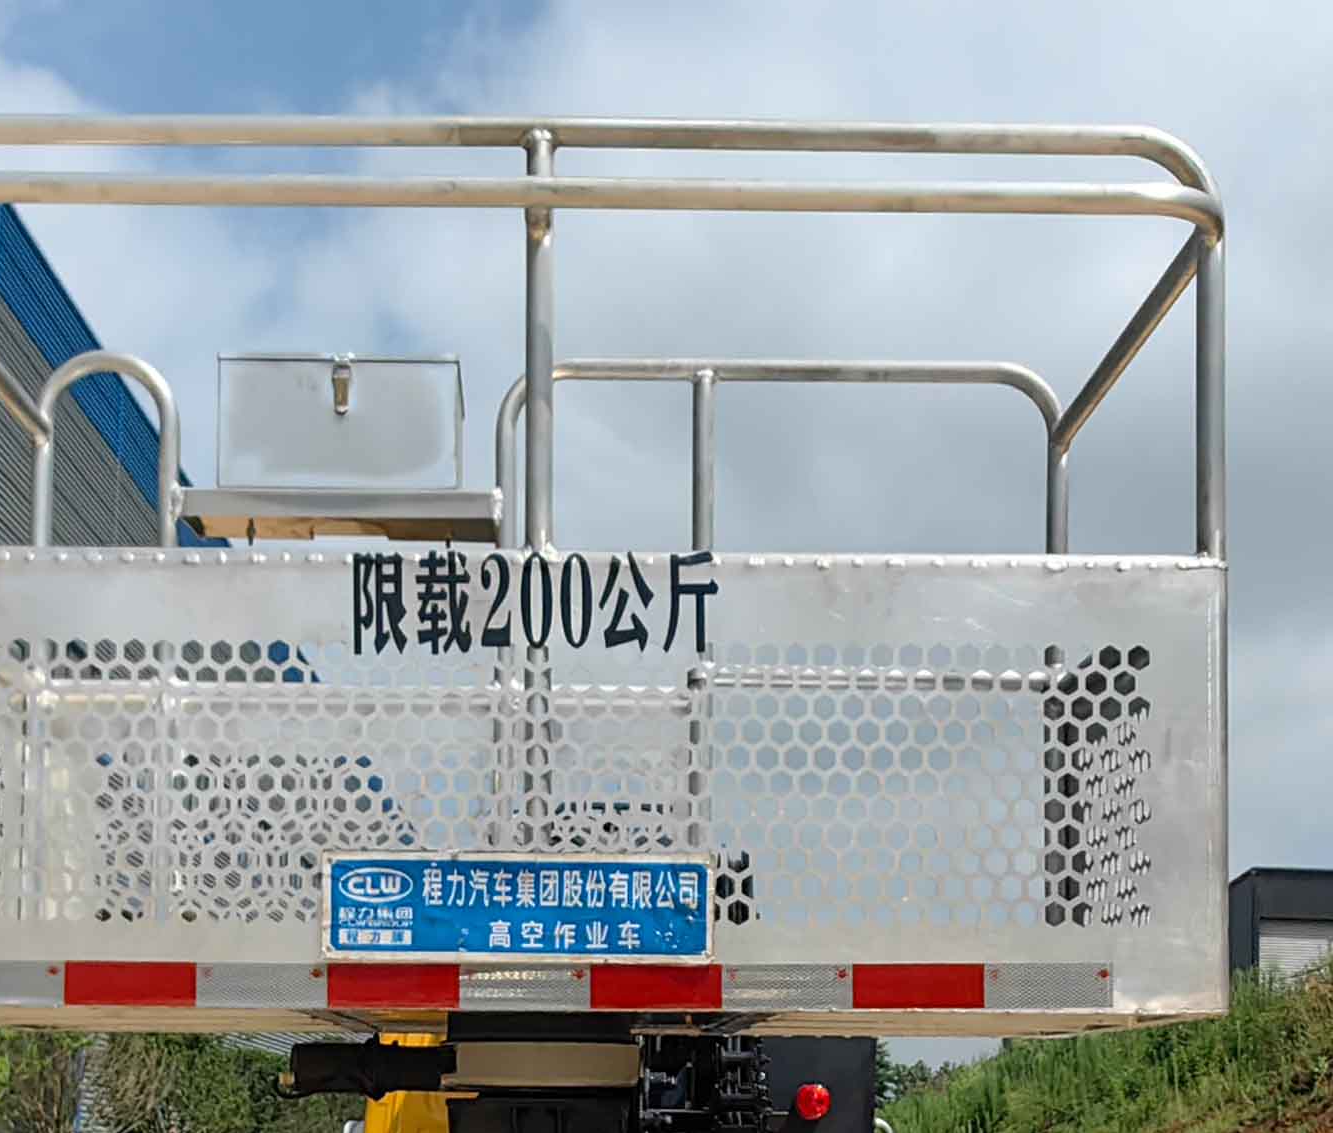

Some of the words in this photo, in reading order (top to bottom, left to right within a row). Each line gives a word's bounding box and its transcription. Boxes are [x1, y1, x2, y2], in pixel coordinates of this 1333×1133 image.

[352, 550, 719, 655] 限载200公斤
[347, 876, 402, 896] CLW
[421, 866, 700, 910] 程力汽车集团股份有限公司
[488, 920, 644, 950] 高空作业车
